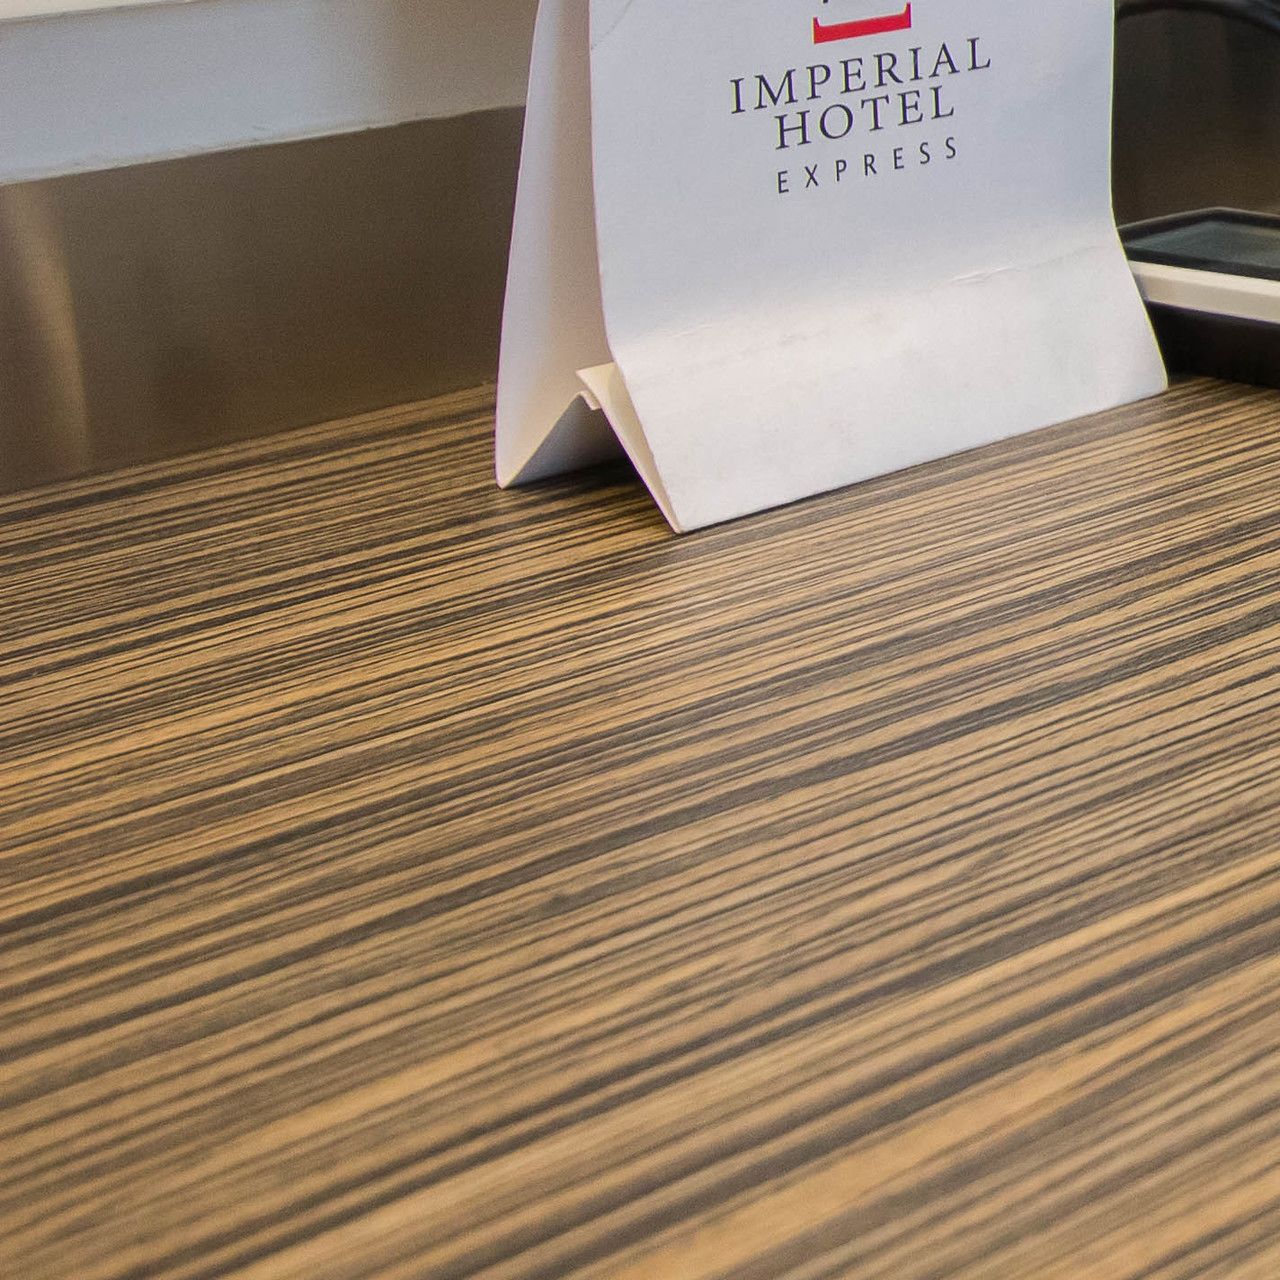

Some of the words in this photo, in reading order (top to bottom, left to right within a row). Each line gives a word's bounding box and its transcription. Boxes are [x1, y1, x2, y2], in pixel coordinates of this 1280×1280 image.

[730, 36, 991, 114] IMPERIAL
[775, 85, 954, 150] HOTEL
[777, 136, 957, 194] EXPRESS
